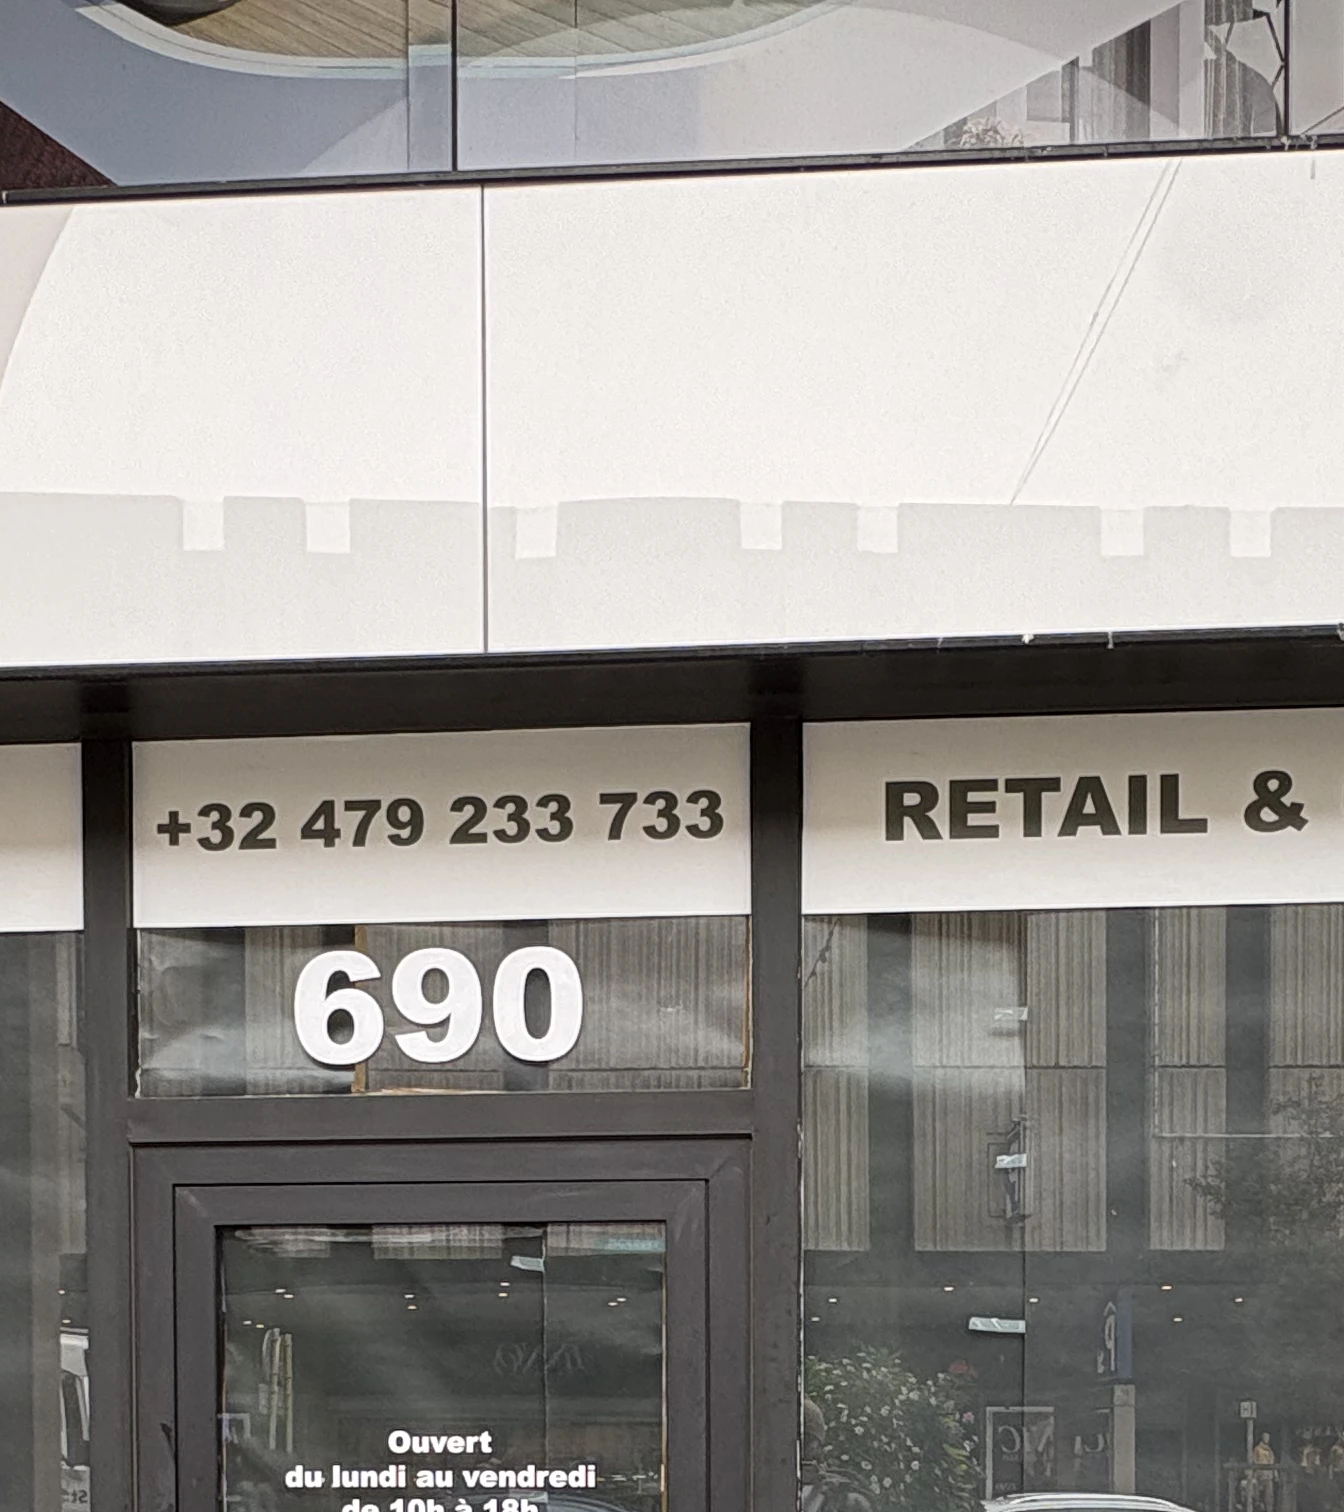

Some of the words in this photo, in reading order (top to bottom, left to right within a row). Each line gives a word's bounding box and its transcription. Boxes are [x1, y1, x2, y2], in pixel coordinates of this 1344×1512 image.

[157, 802, 278, 852] +32
[301, 798, 425, 849] 479
[450, 794, 575, 845] 233
[600, 789, 725, 841] 733
[885, 773, 1209, 842] RETAIL
[1244, 770, 1310, 834] &
[294, 946, 584, 1065] 690
[388, 1430, 493, 1454] Ouvert
[285, 1465, 323, 1489] du
[332, 1465, 407, 1489] lundi
[416, 1471, 453, 1489] au
[463, 1465, 597, 1489] vendredi
